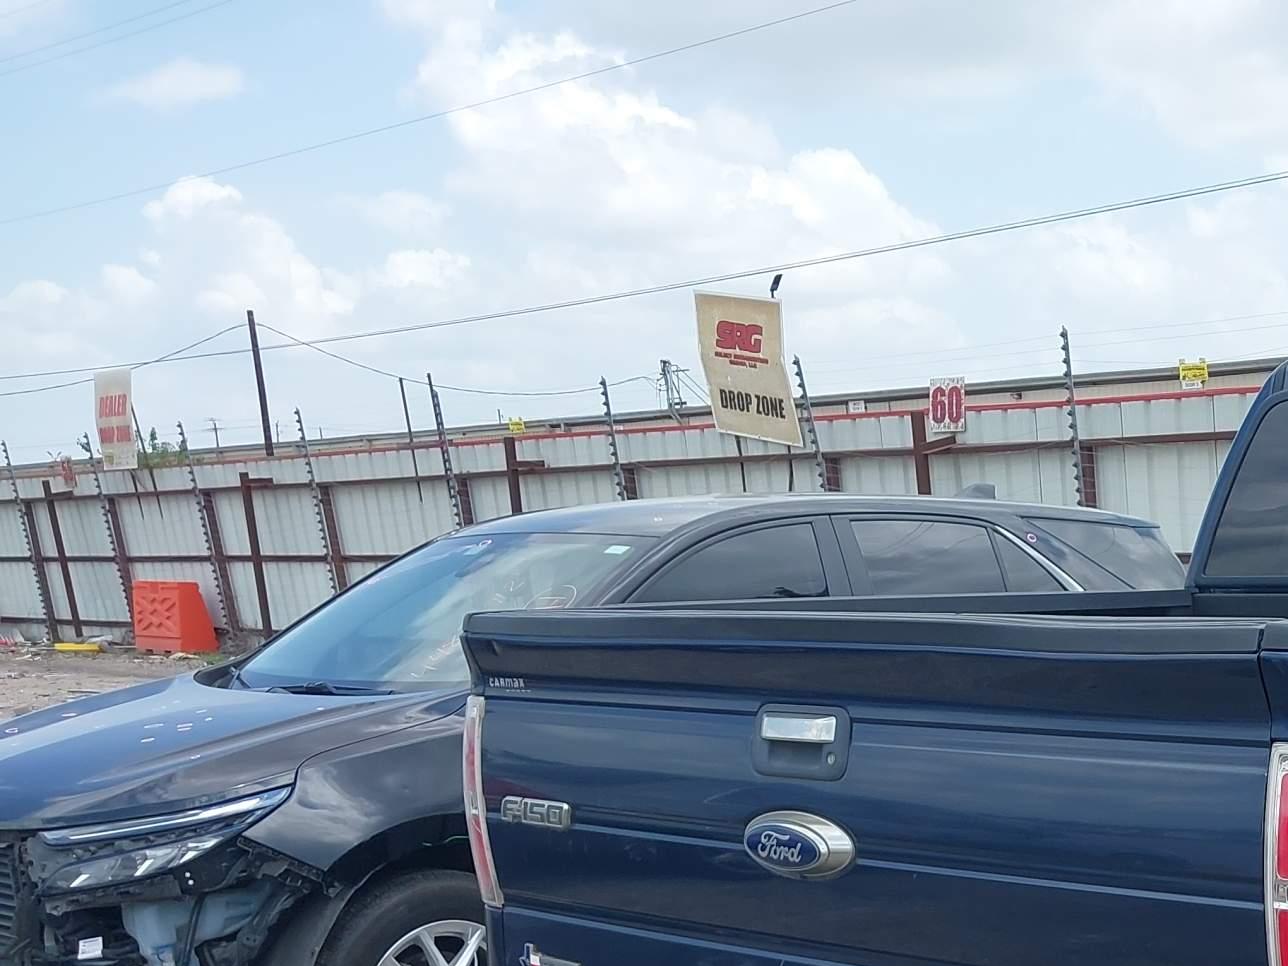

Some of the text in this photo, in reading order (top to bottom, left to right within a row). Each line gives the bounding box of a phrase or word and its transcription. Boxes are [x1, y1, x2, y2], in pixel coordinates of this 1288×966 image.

[715, 319, 764, 354] SRG
[99, 393, 127, 418] DEALER
[719, 388, 786, 420] DROP ZONE
[931, 385, 962, 424] 60
[757, 830, 802, 863] Ford
